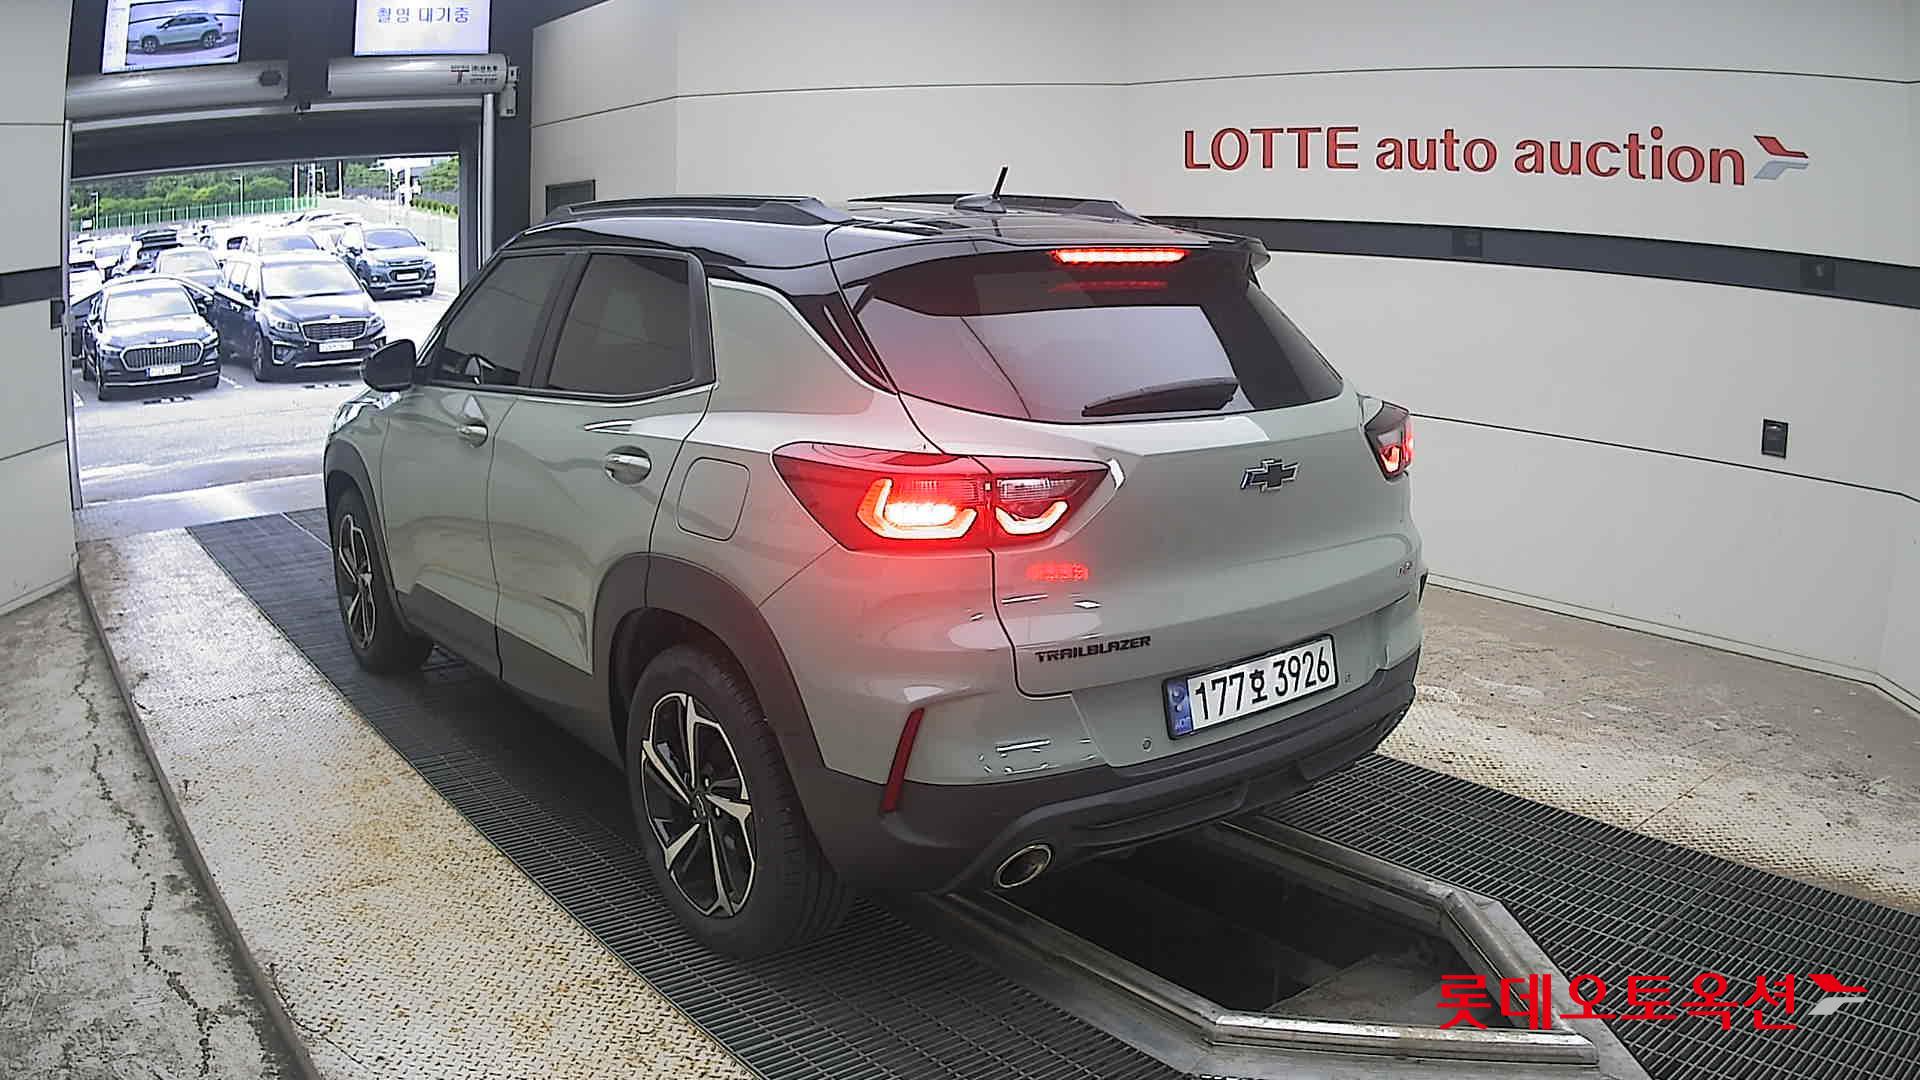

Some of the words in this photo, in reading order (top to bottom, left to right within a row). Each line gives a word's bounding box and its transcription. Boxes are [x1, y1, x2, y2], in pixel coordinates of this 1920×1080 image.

[418, 6, 471, 24] 대기중
[1184, 127, 1359, 170] LOTTE
[1376, 128, 1498, 172] auto
[1514, 126, 1745, 186] auction
[1035, 635, 1151, 662] TRAILBLAZER
